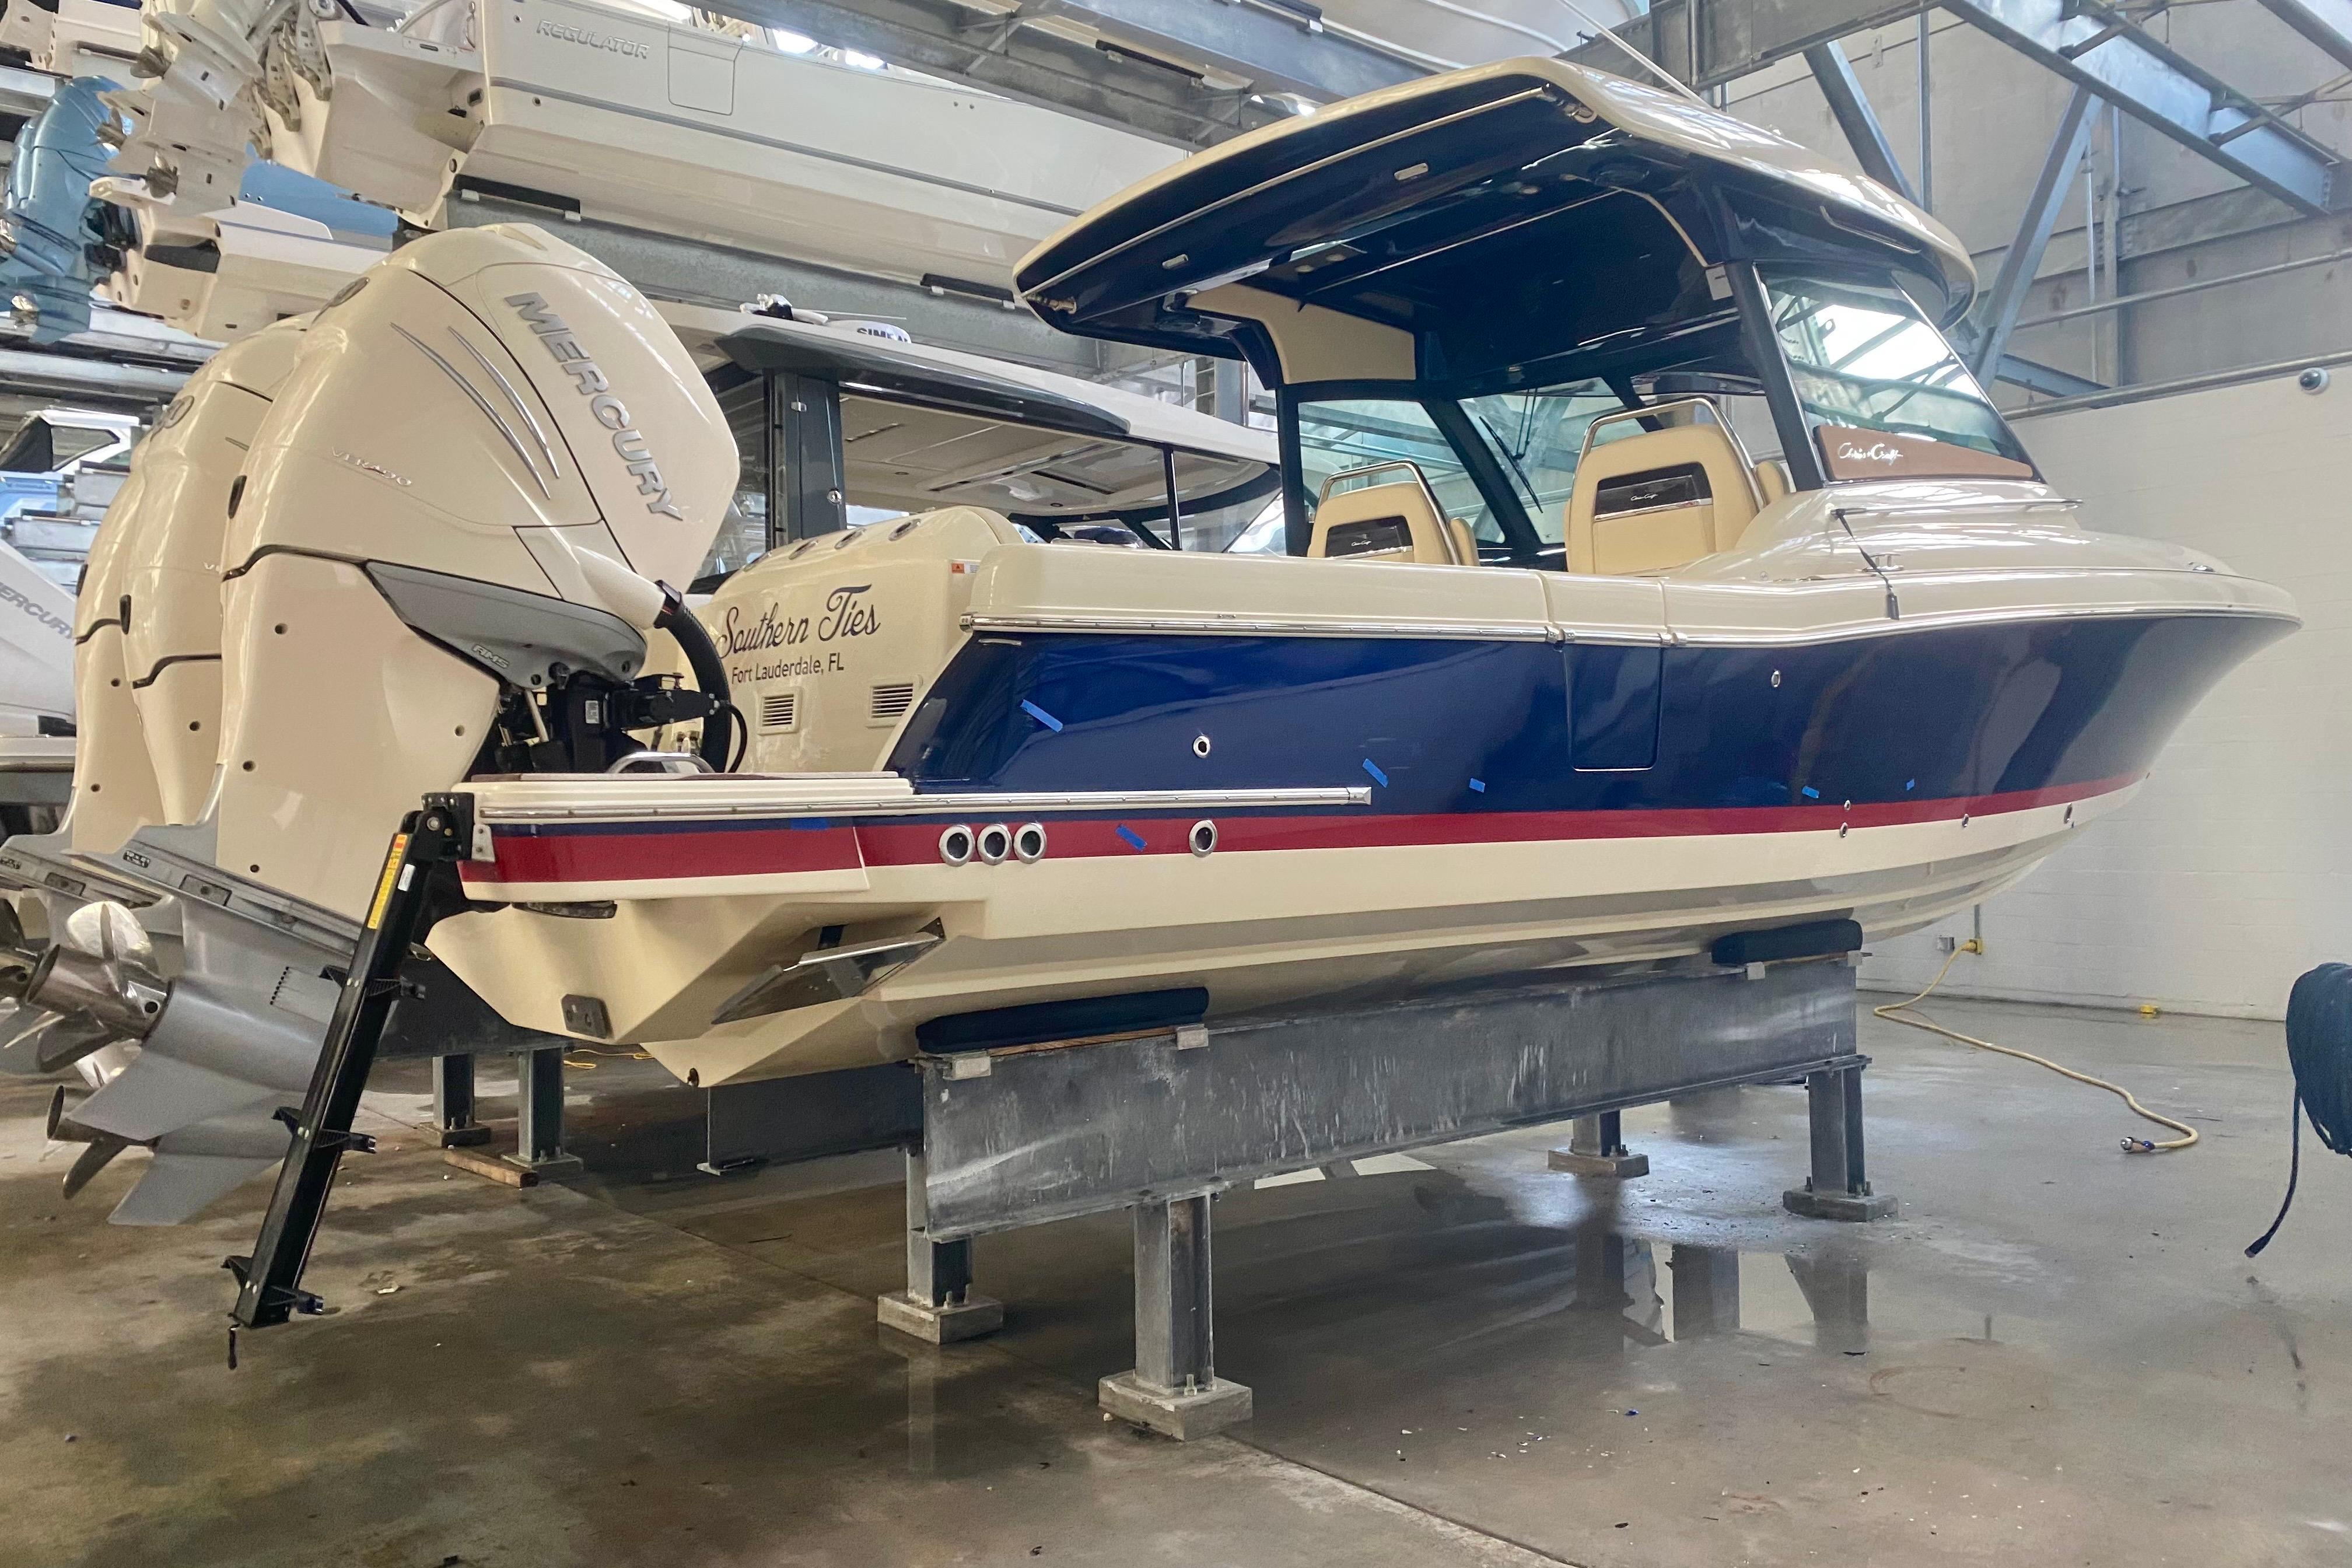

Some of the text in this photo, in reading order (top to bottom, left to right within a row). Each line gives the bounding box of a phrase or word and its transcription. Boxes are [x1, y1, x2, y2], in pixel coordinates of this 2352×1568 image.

[536, 18, 650, 60] REGULATOR
[503, 291, 683, 522] MERCURY
[715, 583, 881, 659] Southern Ties
[473, 645, 509, 668] AMS
[731, 652, 845, 685] Fort Lauderdale, FL
